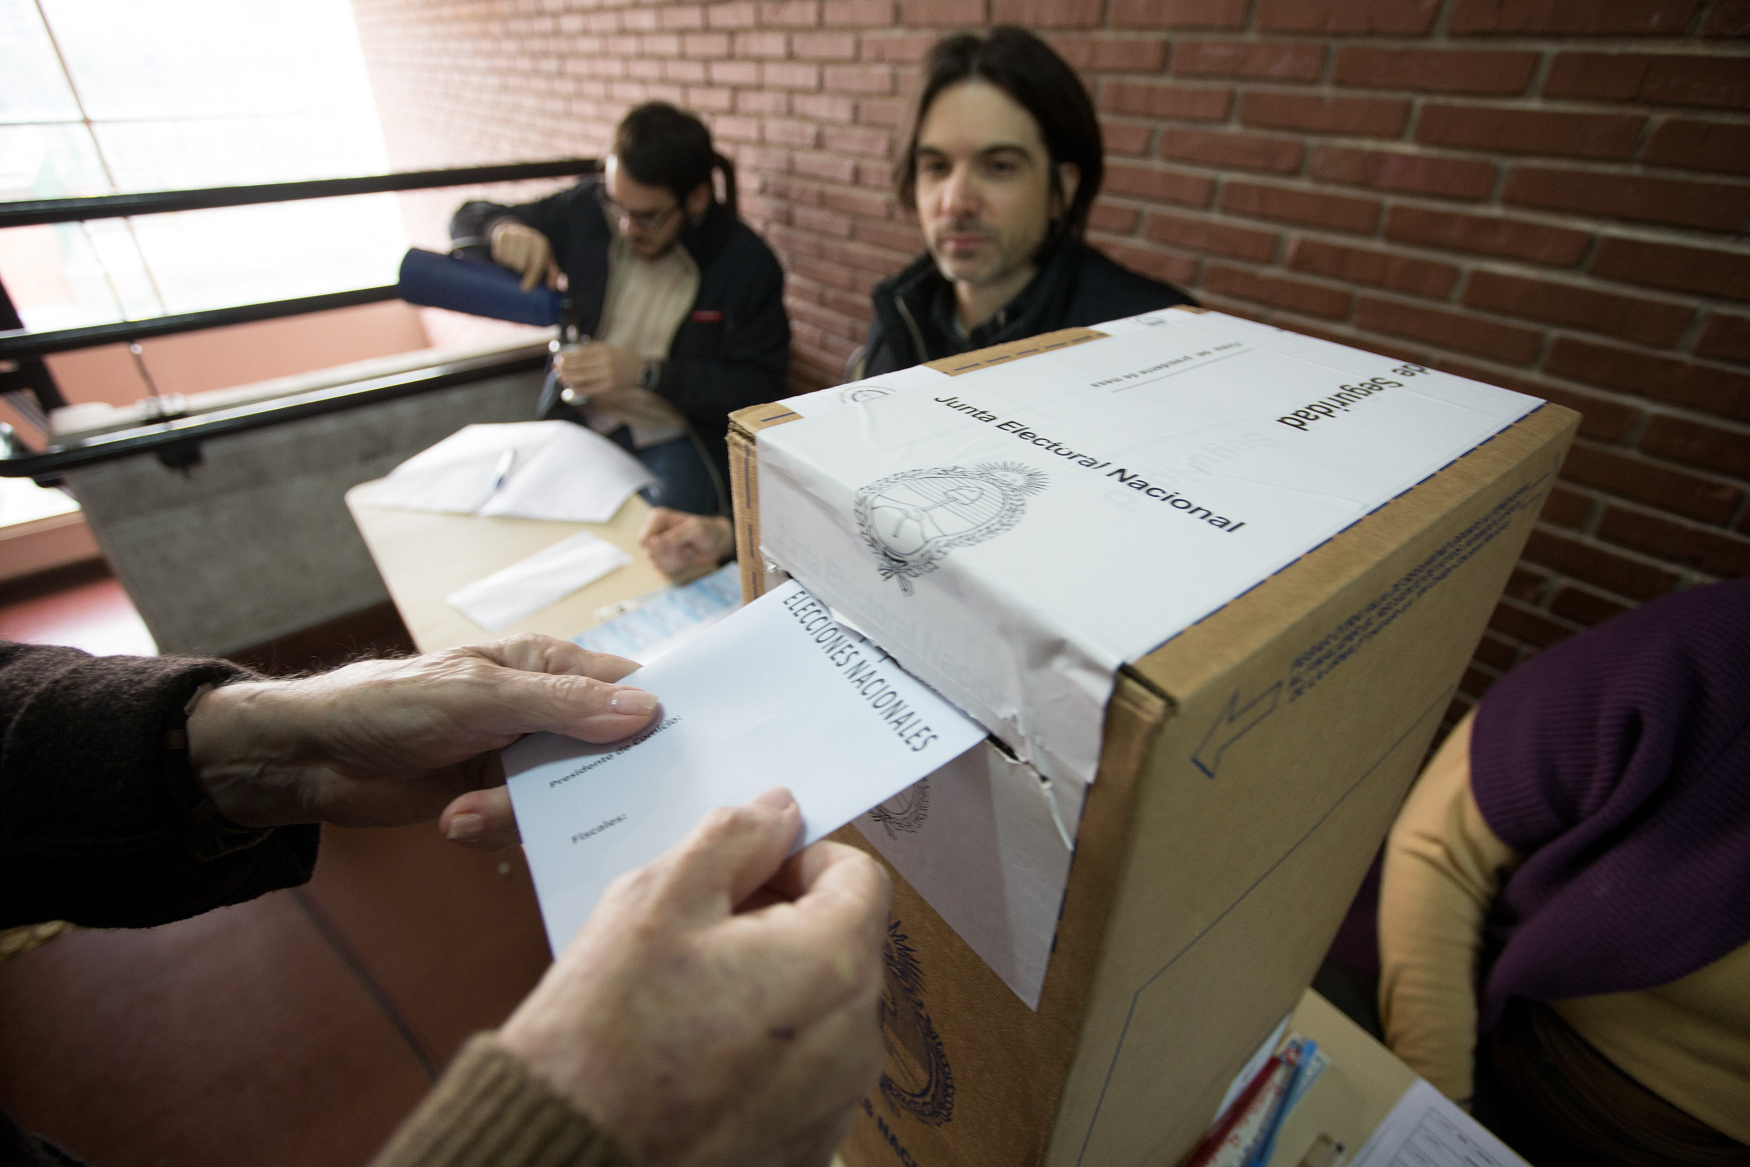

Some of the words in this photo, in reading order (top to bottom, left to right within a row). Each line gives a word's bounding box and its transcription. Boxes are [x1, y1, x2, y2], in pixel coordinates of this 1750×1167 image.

[1276, 377, 1404, 431] Seguridad
[934, 396, 998, 423] Junta
[995, 420, 1111, 470] Electoral
[1105, 467, 1246, 533] Nacional
[782, 590, 859, 667] ELECCIONES
[843, 659, 939, 752] NACIONALES
[549, 754, 614, 788] Presidente
[615, 744, 631, 755] de
[571, 813, 628, 844] Fiscales:
